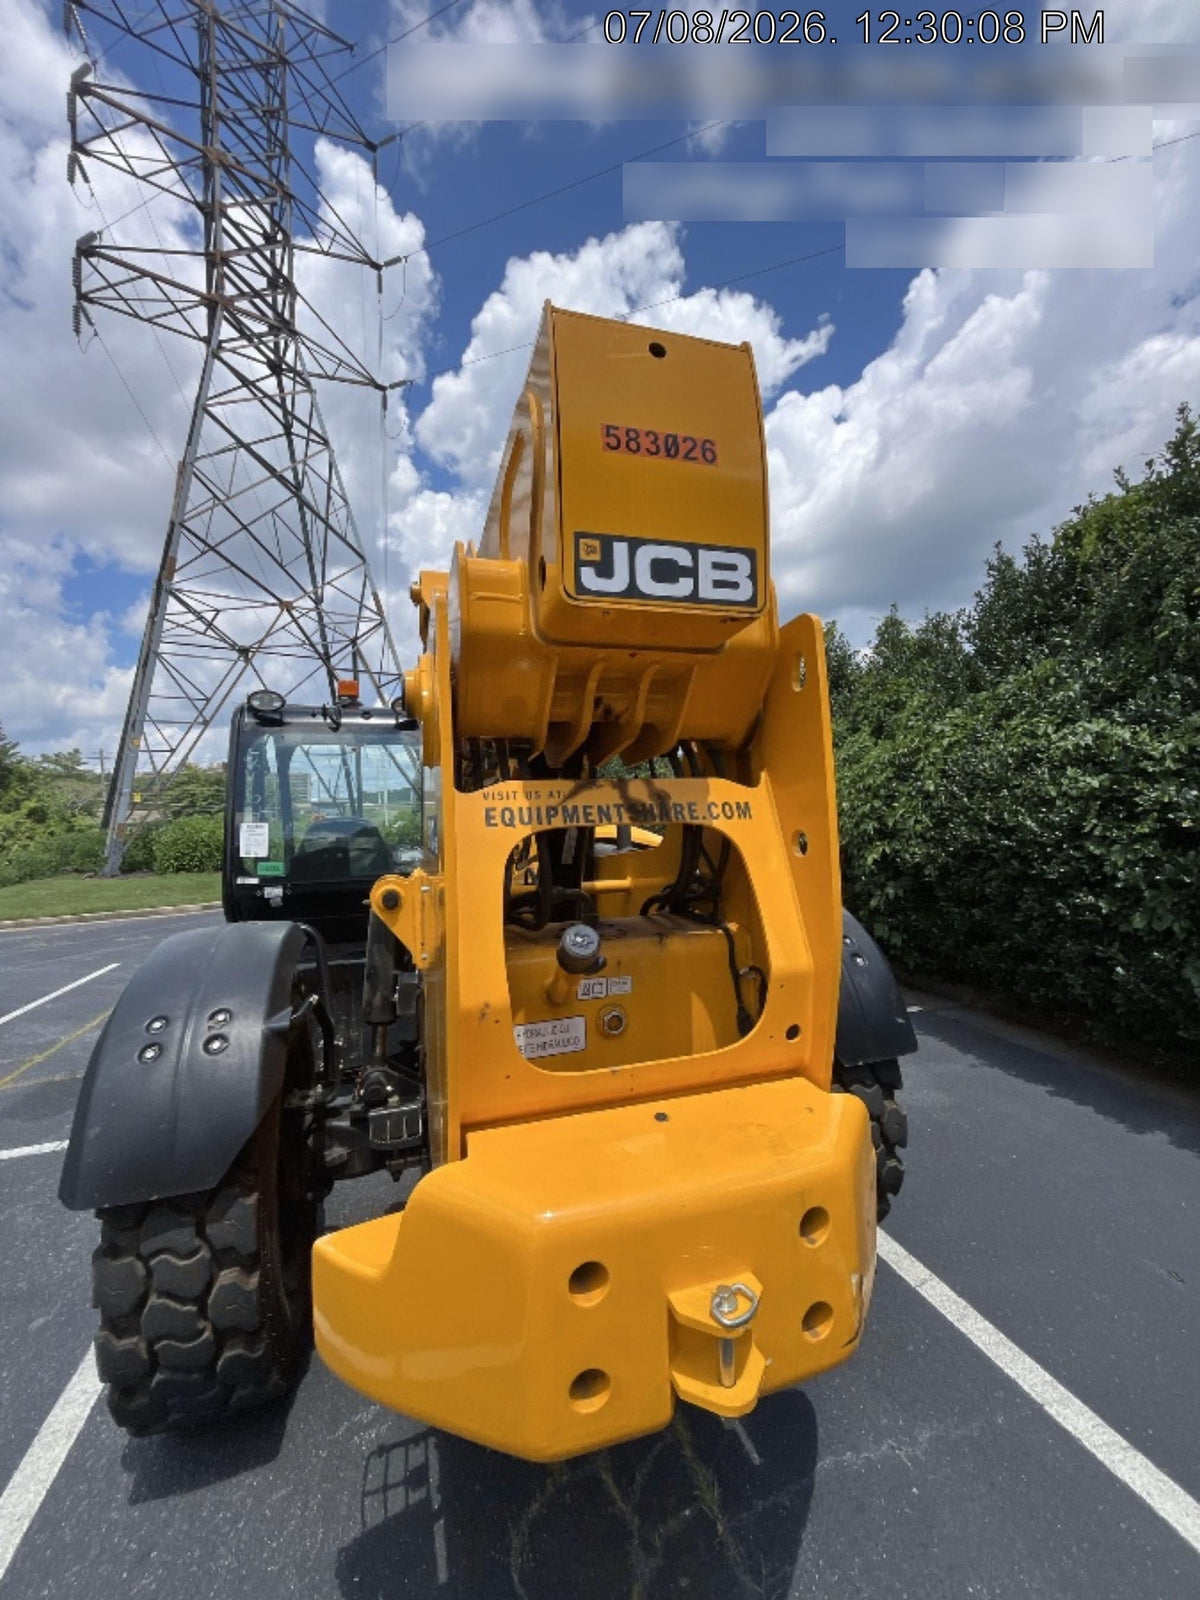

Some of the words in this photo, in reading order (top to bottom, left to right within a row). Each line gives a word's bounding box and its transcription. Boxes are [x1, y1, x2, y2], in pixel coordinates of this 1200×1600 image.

[604, 425, 718, 464] 583026
[579, 541, 753, 602] JCB
[483, 790, 518, 801] VISIT
[526, 790, 541, 801] US
